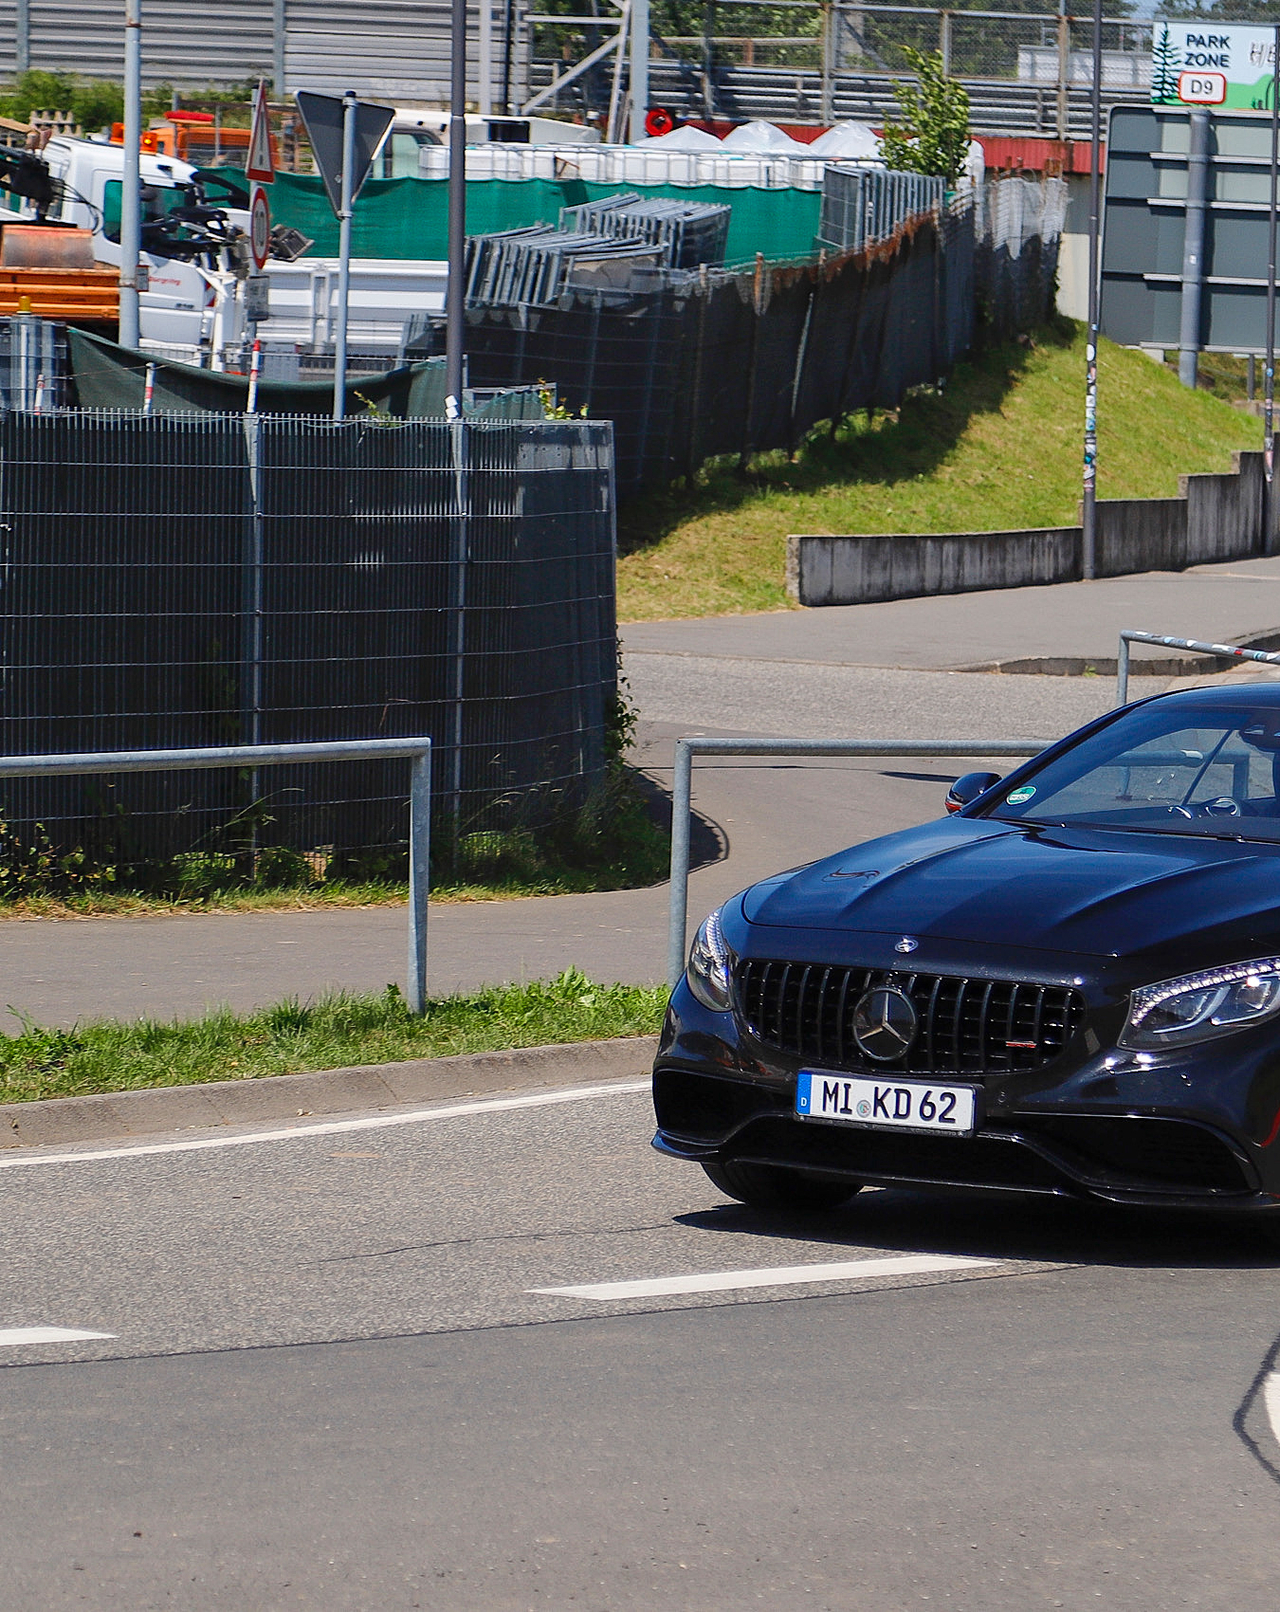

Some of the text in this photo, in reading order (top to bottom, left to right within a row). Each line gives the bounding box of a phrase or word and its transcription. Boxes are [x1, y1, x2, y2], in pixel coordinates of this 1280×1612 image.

[1186, 33, 1231, 49] PARK
[1184, 52, 1231, 68] ZONE
[1190, 79, 1214, 95] D9
[822, 1080, 957, 1124] MI KD 62
